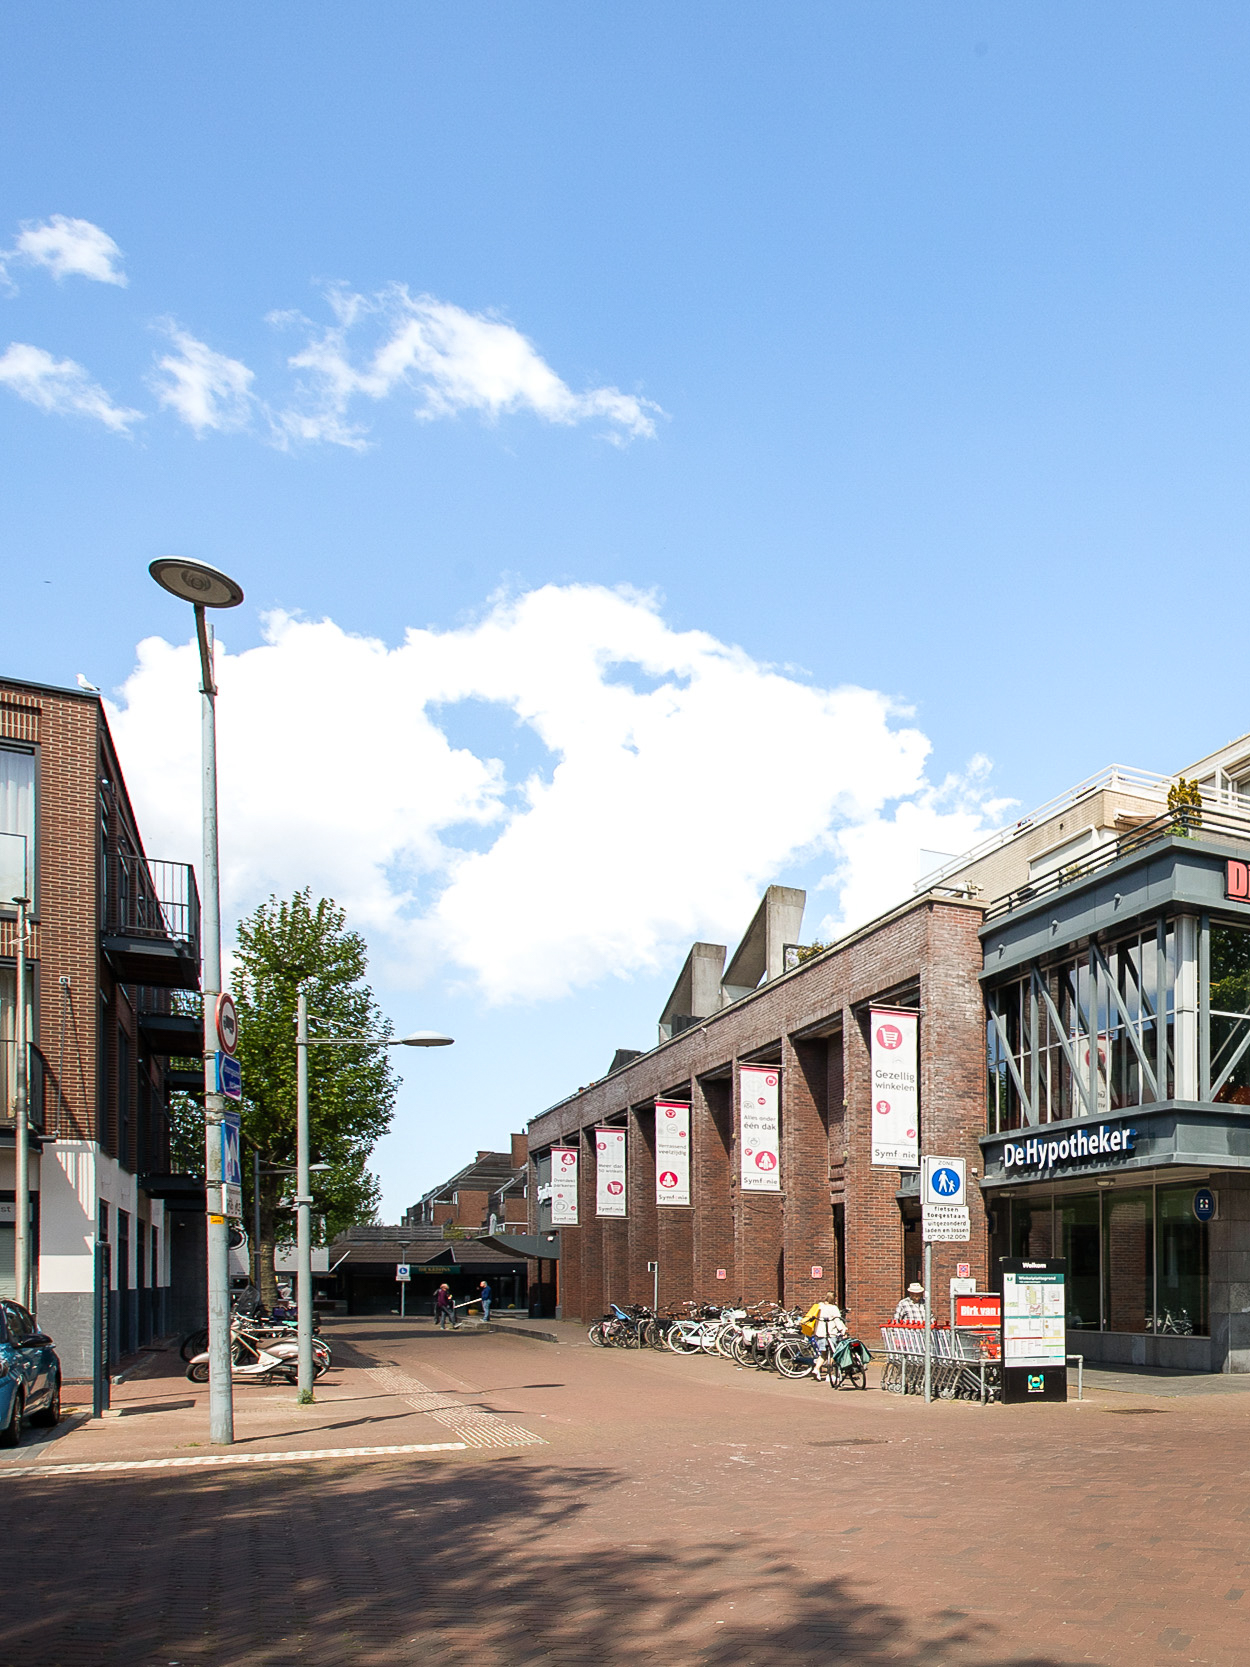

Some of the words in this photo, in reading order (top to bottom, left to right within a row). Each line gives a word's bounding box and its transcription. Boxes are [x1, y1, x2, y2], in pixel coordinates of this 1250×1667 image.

[875, 1069, 915, 1083] Gezellig
[875, 1082, 915, 1092] winkelen
[743, 1121, 760, 1130] één
[761, 1123, 777, 1132] dak
[1004, 1143, 1024, 1168] De
[1026, 1125, 1131, 1169] Hypotheker
[927, 1212, 966, 1220] toegestaan
[927, 1220, 967, 1228] uitgezonderd
[960, 1305, 979, 1316] Dirk
[980, 1307, 997, 1316] van
